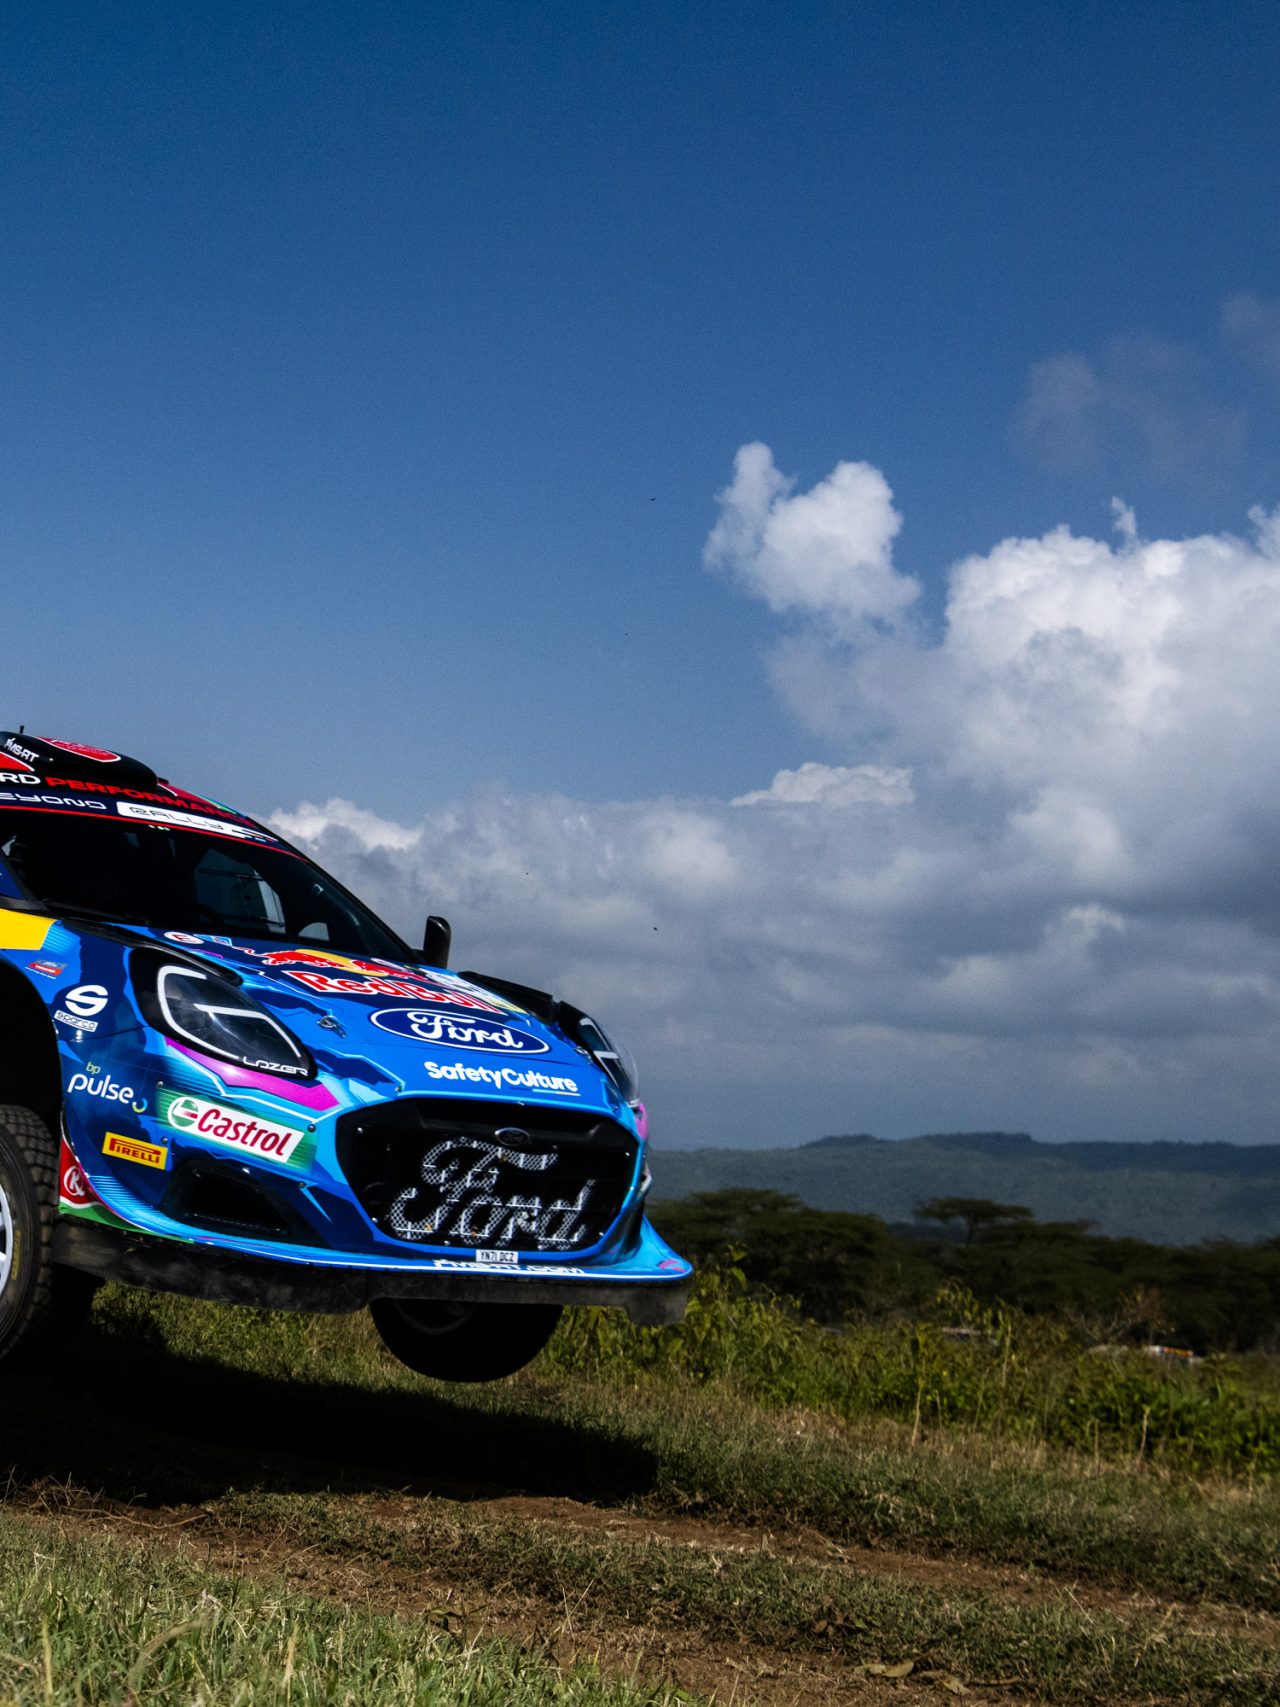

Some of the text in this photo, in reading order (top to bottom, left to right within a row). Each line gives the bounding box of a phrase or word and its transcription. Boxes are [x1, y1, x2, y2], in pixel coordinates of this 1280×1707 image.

[287, 970, 410, 998] Red
[390, 980, 504, 1014] Bull
[57, 1011, 97, 1030] sparco
[408, 1012, 524, 1048] Ford
[86, 1062, 101, 1075] bp
[424, 1060, 578, 1093] SafetyCulture
[68, 1072, 134, 1105] pulse
[197, 1108, 292, 1157] Castrol
[109, 1137, 162, 1164] PIRELLI
[389, 1136, 596, 1251] Ford
